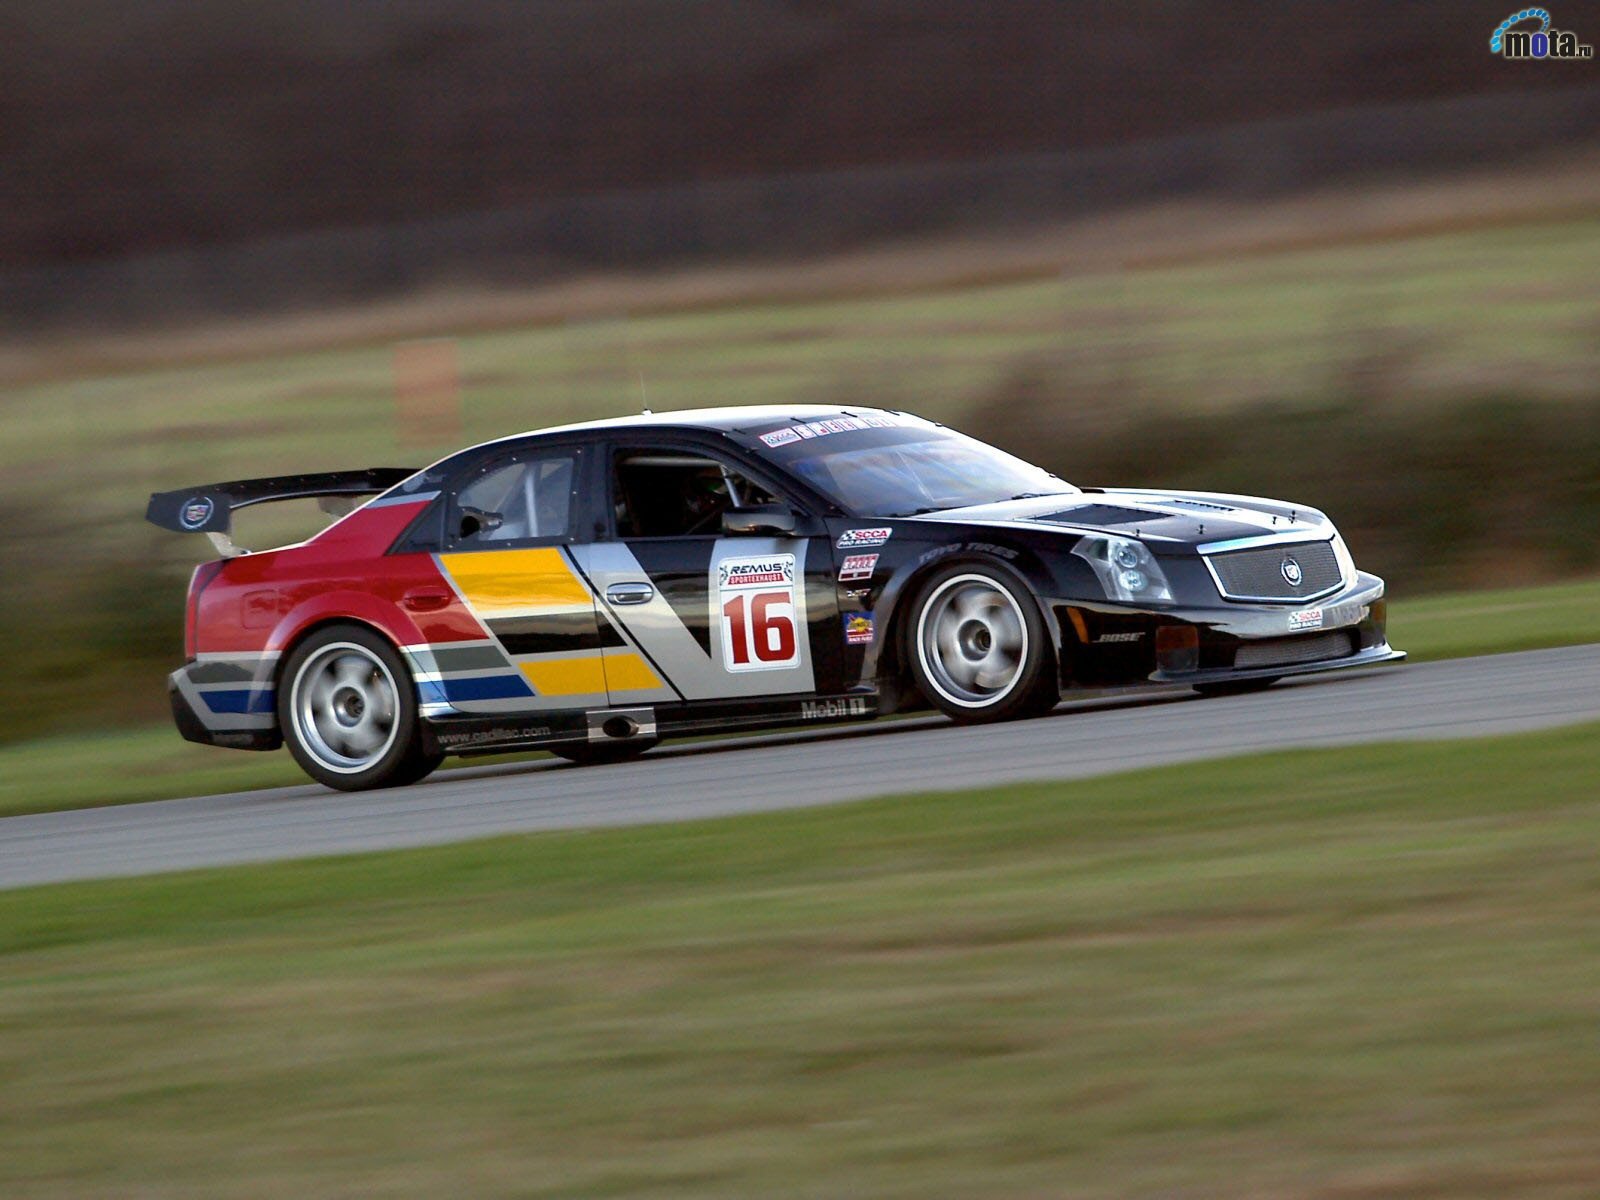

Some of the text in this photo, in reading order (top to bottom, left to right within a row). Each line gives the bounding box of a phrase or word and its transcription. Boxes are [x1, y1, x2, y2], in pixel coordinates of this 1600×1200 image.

[854, 530, 888, 539] SCCA
[730, 563, 782, 574] REMUS
[730, 573, 782, 584] SPORTEXHAUST
[1299, 611, 1321, 621] SCCA
[723, 591, 795, 664] 16
[1092, 632, 1146, 643] BOSE
[801, 700, 847, 719] Mobil
